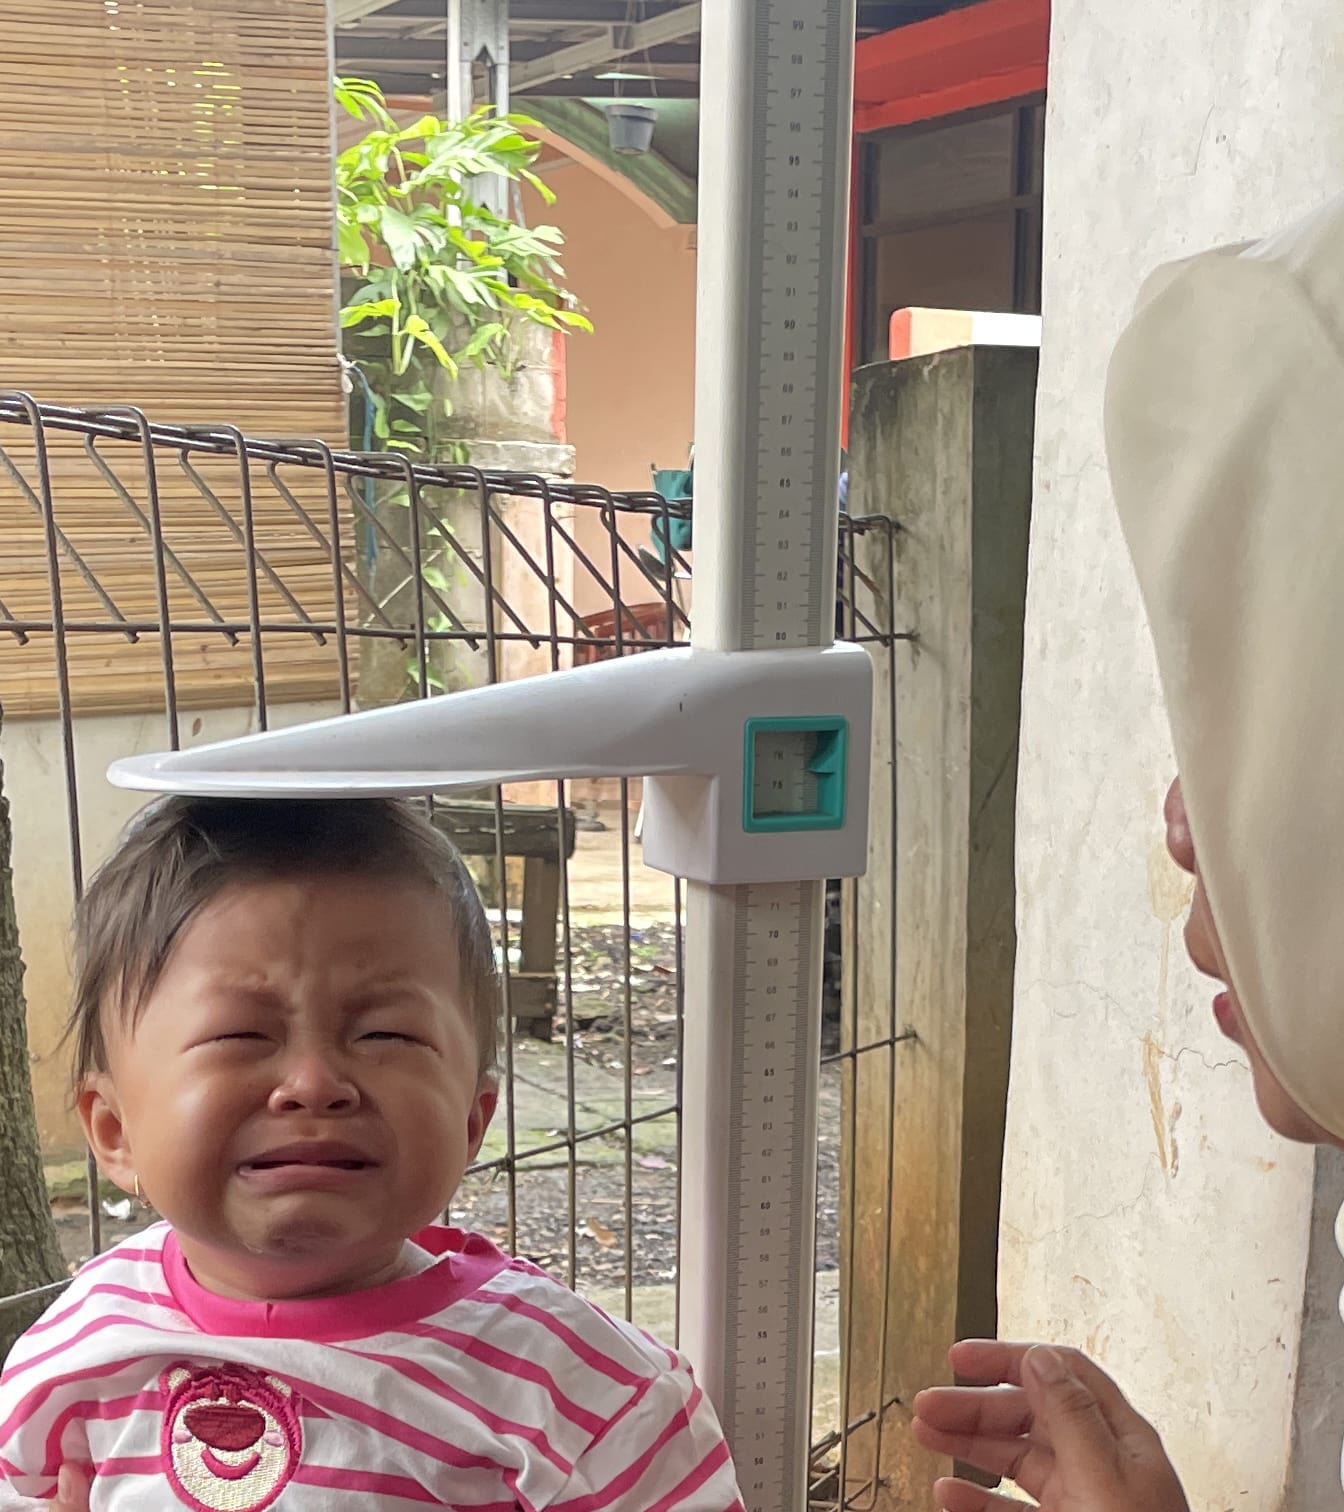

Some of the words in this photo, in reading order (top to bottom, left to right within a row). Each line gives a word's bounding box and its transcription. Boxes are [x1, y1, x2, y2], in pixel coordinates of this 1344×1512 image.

[788, 155, 800, 166] 95
[784, 319, 796, 330] 90
[775, 632, 787, 641] 80
[770, 902, 780, 911] 71
[768, 930, 779, 939] 70
